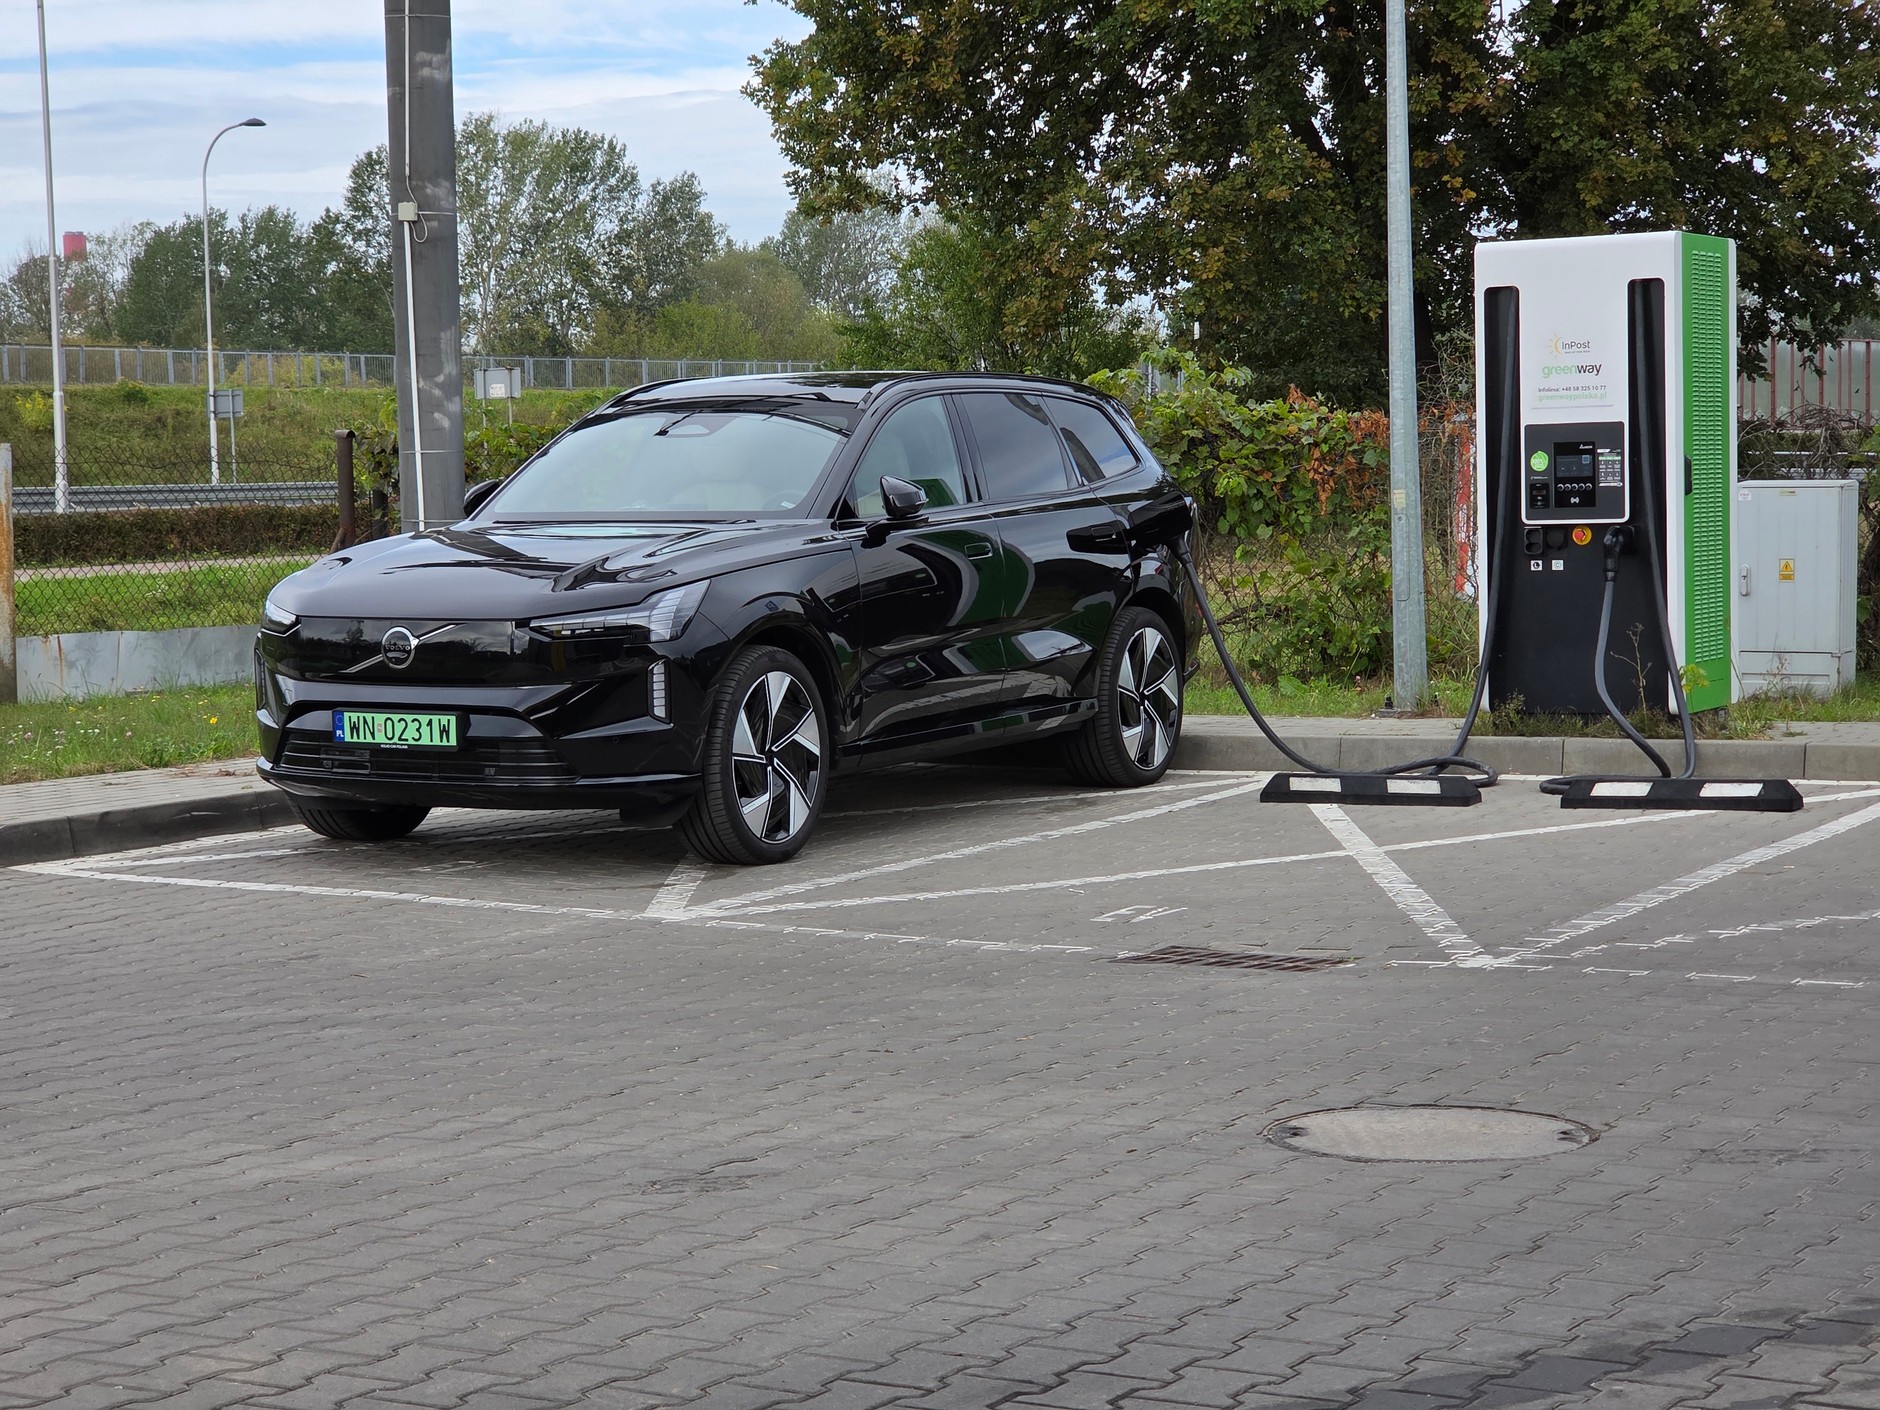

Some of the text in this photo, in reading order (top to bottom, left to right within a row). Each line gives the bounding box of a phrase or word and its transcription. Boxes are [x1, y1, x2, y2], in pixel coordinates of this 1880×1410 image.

[1561, 340, 1591, 350] InPost
[1542, 364, 1602, 379] greenway
[1537, 391, 1608, 402] greenwaypolska.pl
[336, 730, 345, 738] PL
[348, 715, 451, 744] WN 0231W
